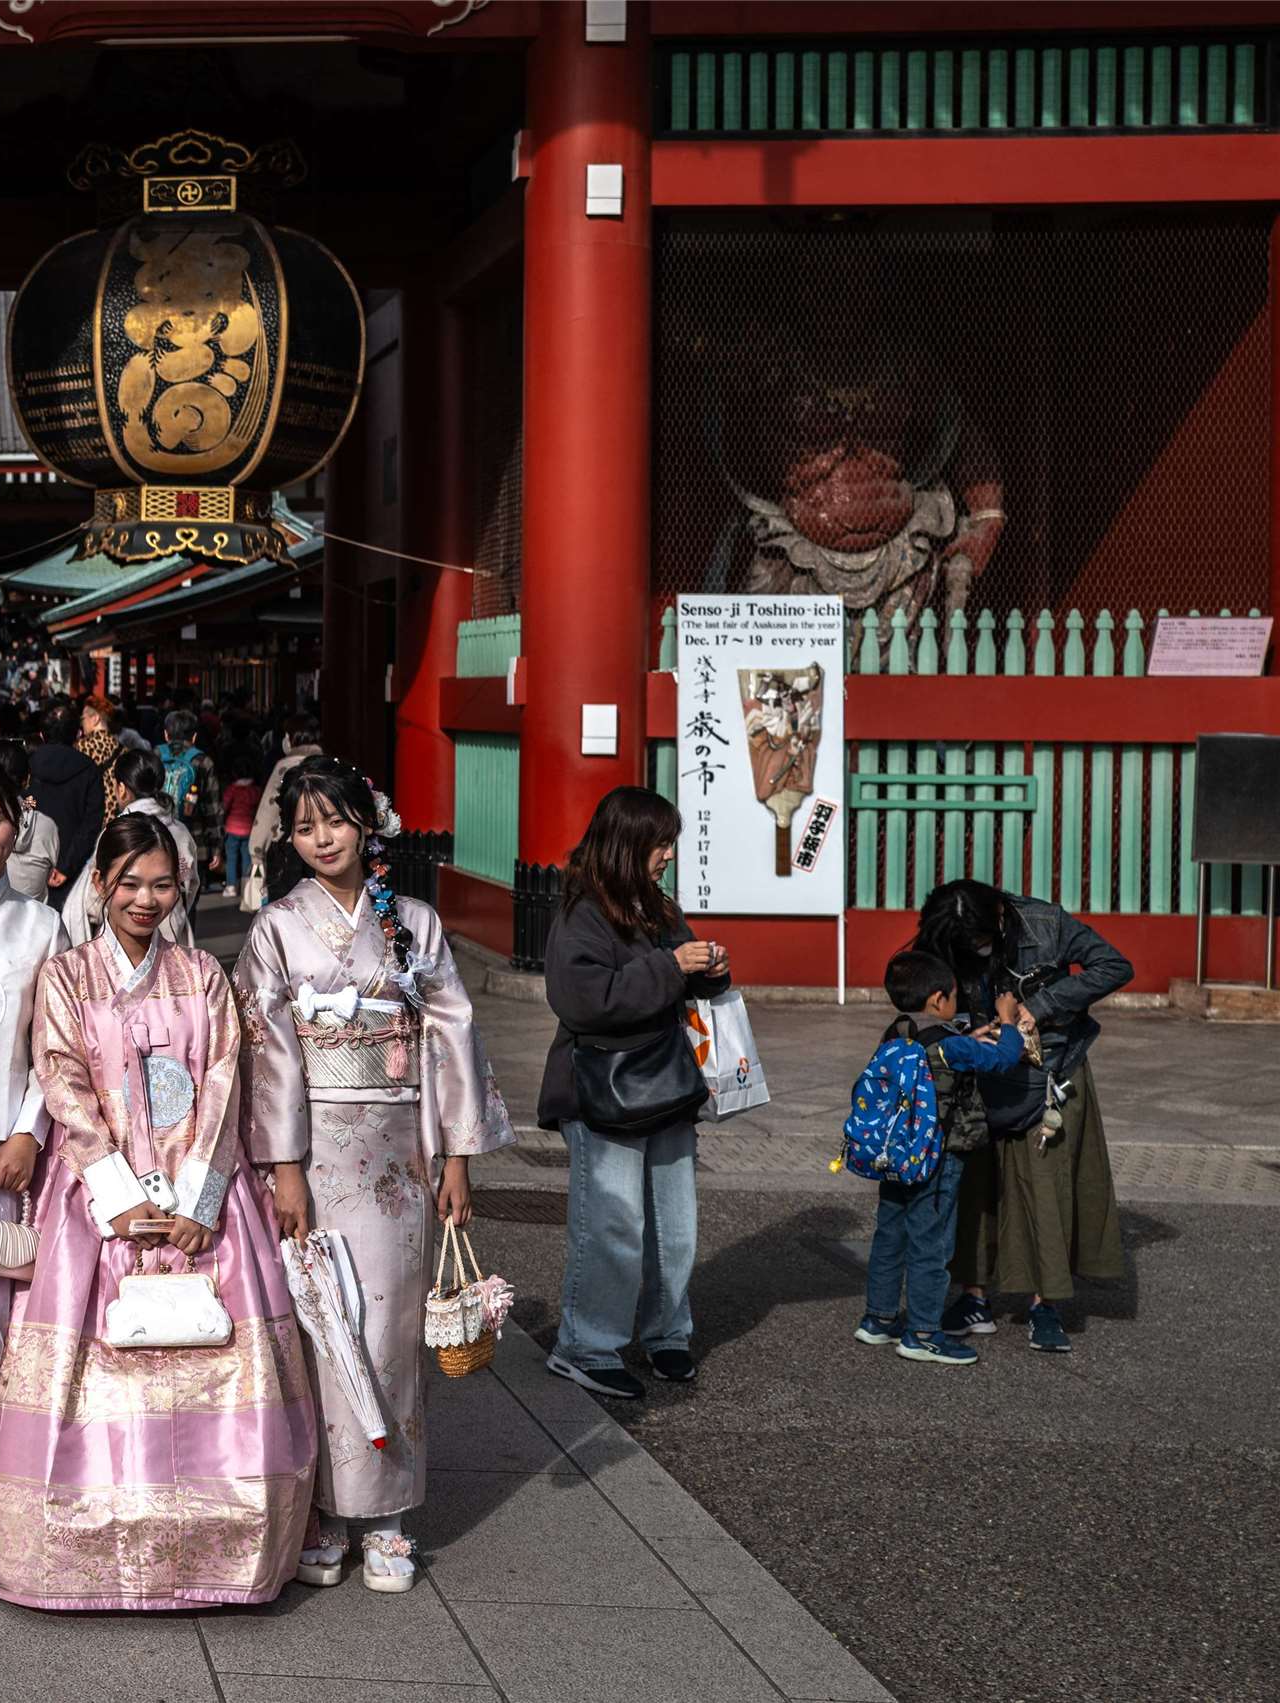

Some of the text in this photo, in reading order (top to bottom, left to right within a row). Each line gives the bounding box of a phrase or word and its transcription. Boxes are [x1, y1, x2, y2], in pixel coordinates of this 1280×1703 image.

[681, 603, 841, 618] Senso-ji Toshino-ichi
[722, 620, 738, 629] fair
[740, 620, 749, 629] of
[790, 620, 798, 629] in
[801, 620, 814, 629] the
[685, 634, 710, 646] Dec.
[715, 634, 728, 646] 17
[749, 634, 763, 646] 19
[771, 636, 805, 648] every
[810, 636, 837, 648] year
[681, 711, 730, 796] 歳の市
